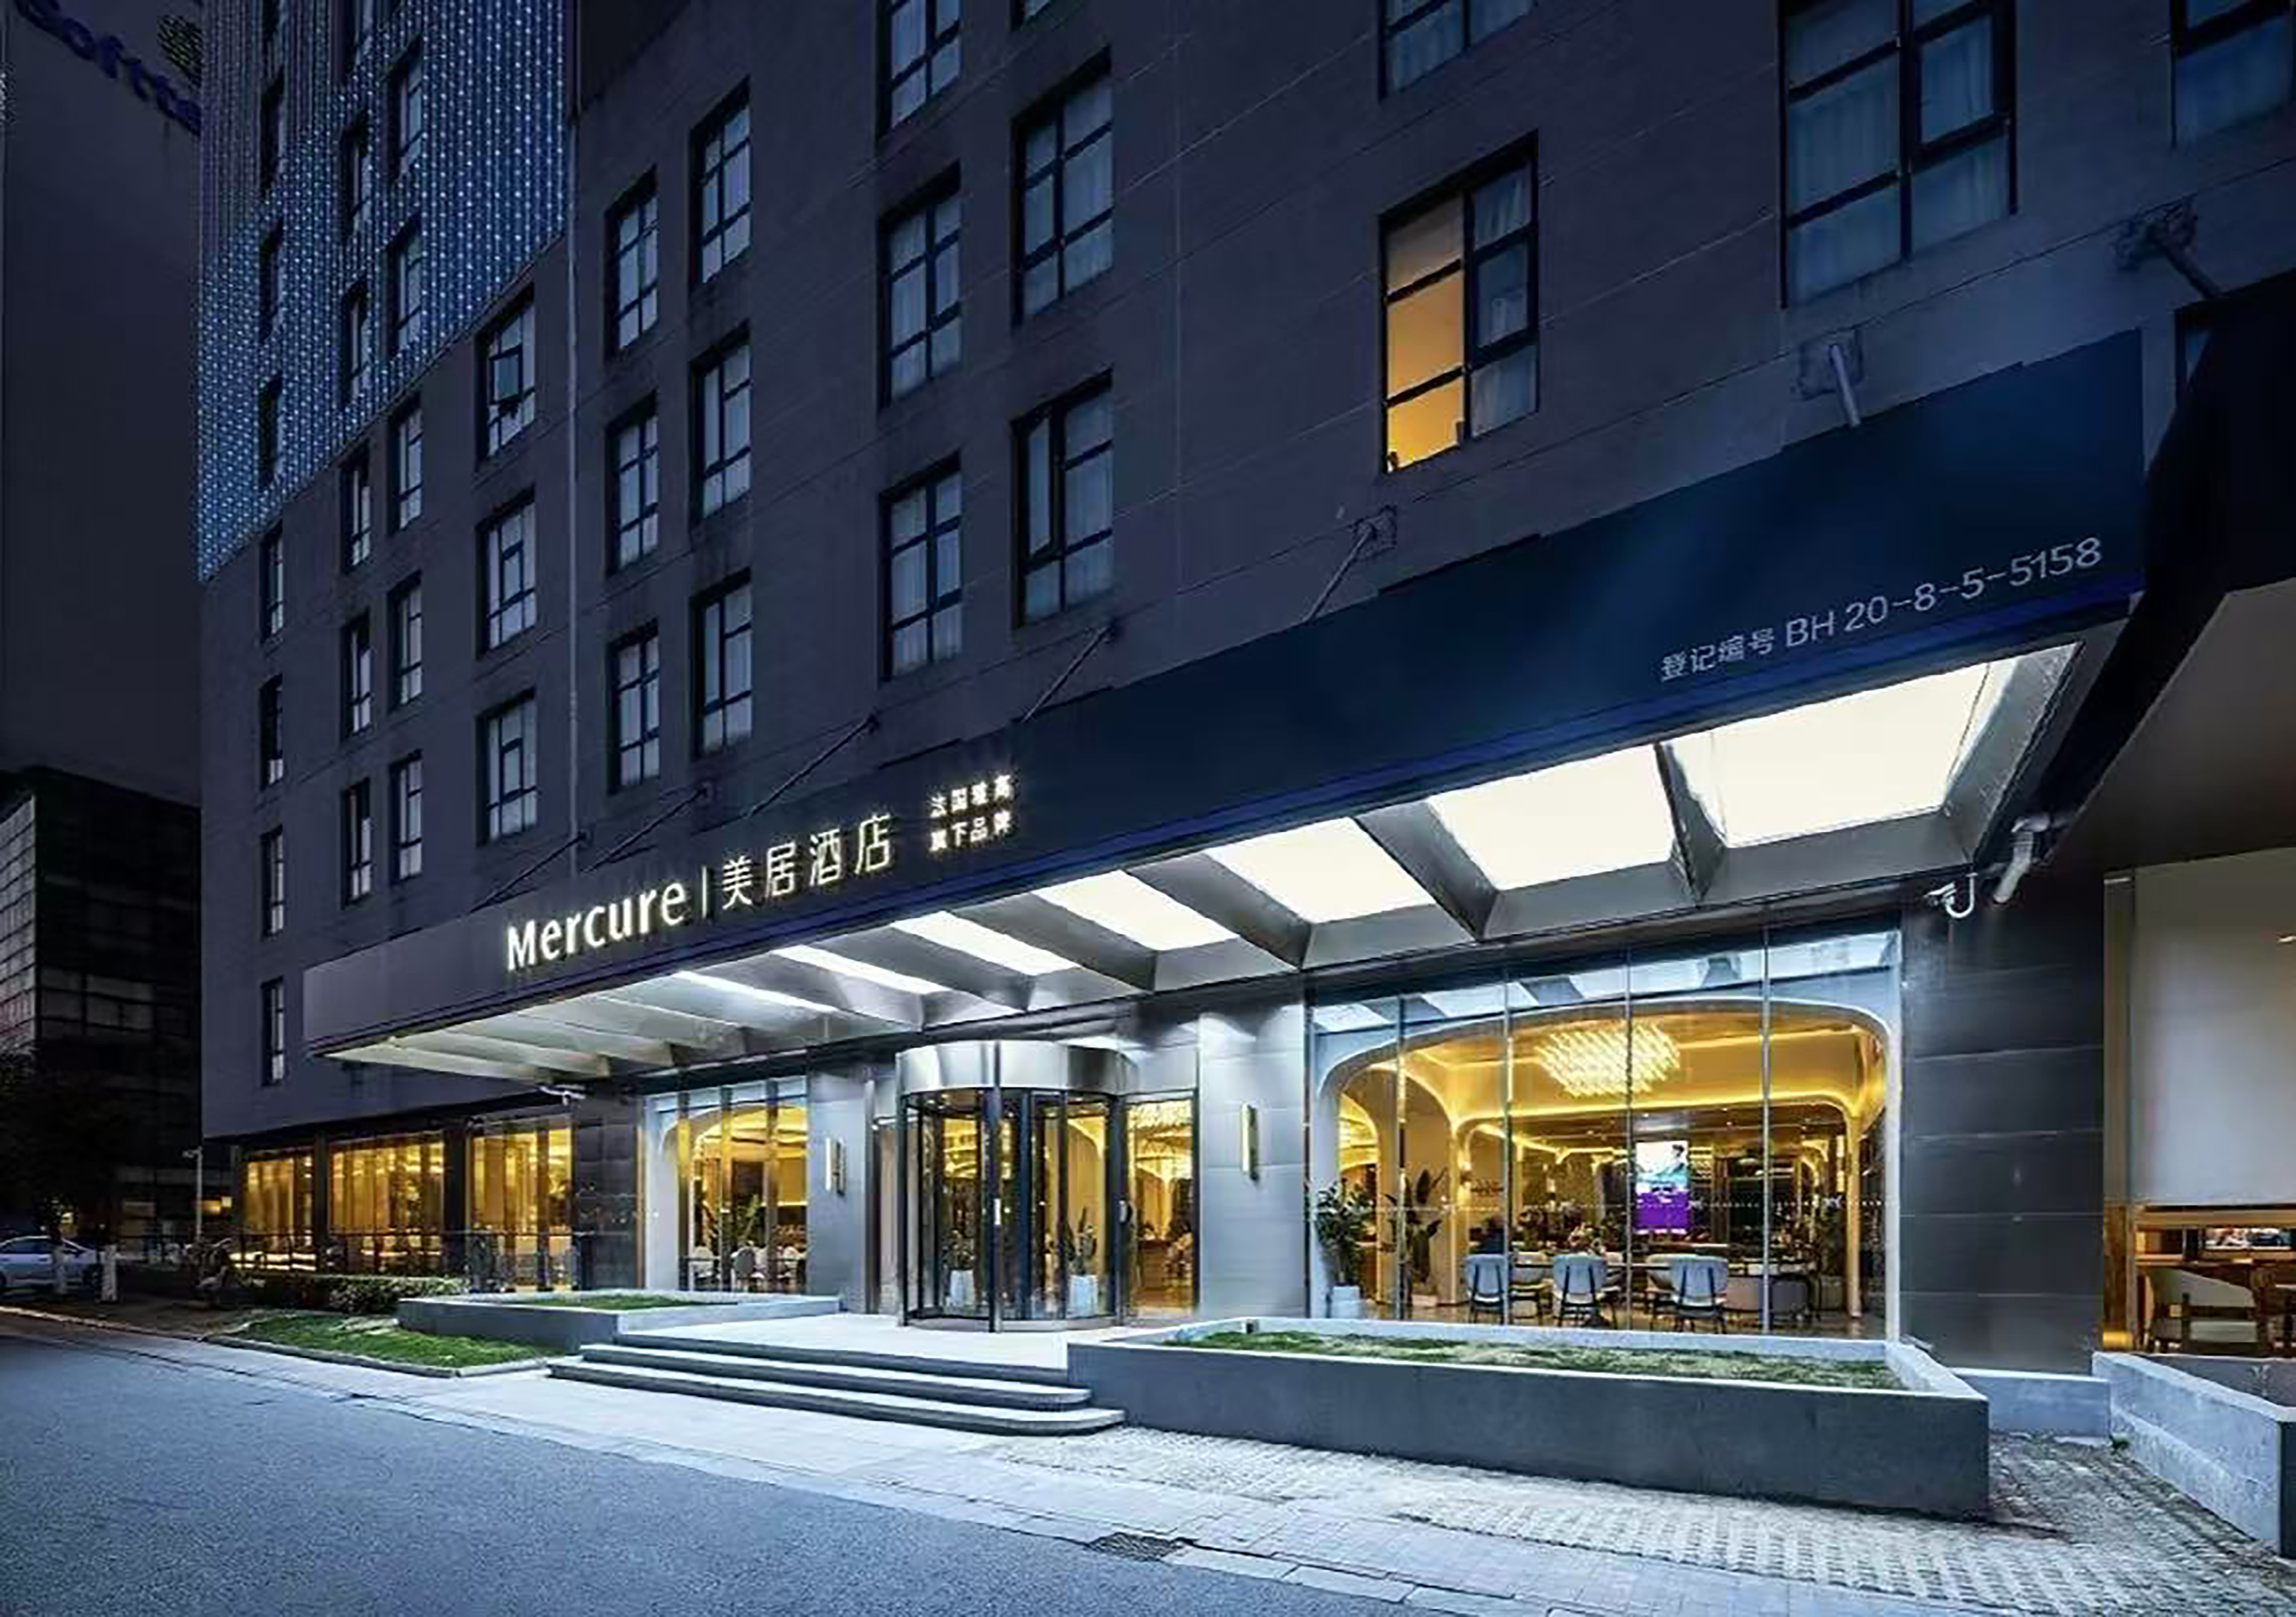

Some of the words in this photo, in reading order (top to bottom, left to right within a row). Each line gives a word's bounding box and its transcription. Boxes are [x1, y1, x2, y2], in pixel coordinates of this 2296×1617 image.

[1786, 611, 1834, 647] BH
[1844, 537, 2101, 631] 20-8-5-5158
[508, 882, 686, 971] Mercure
[722, 812, 891, 909] 美居酒店
